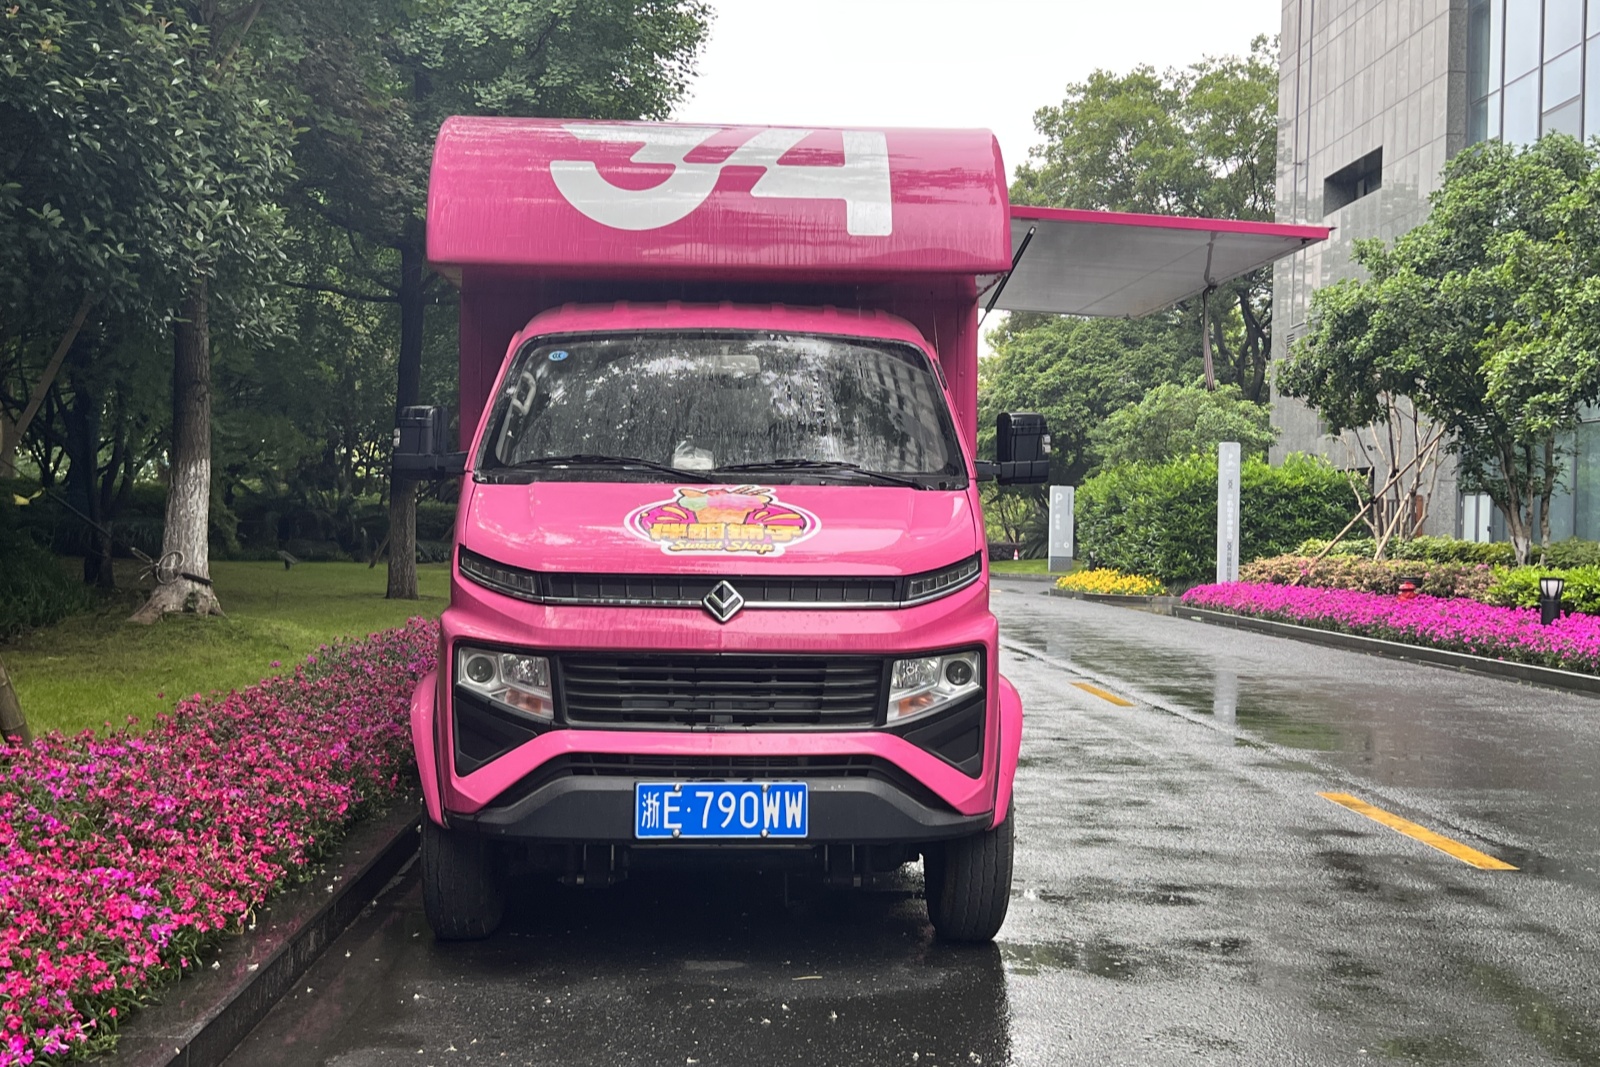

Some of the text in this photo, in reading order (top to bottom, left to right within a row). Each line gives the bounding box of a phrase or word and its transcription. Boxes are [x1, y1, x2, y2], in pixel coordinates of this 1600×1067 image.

[549, 123, 892, 236] 34
[1055, 493, 1063, 504] P
[670, 539, 774, 554] Sweet Shop
